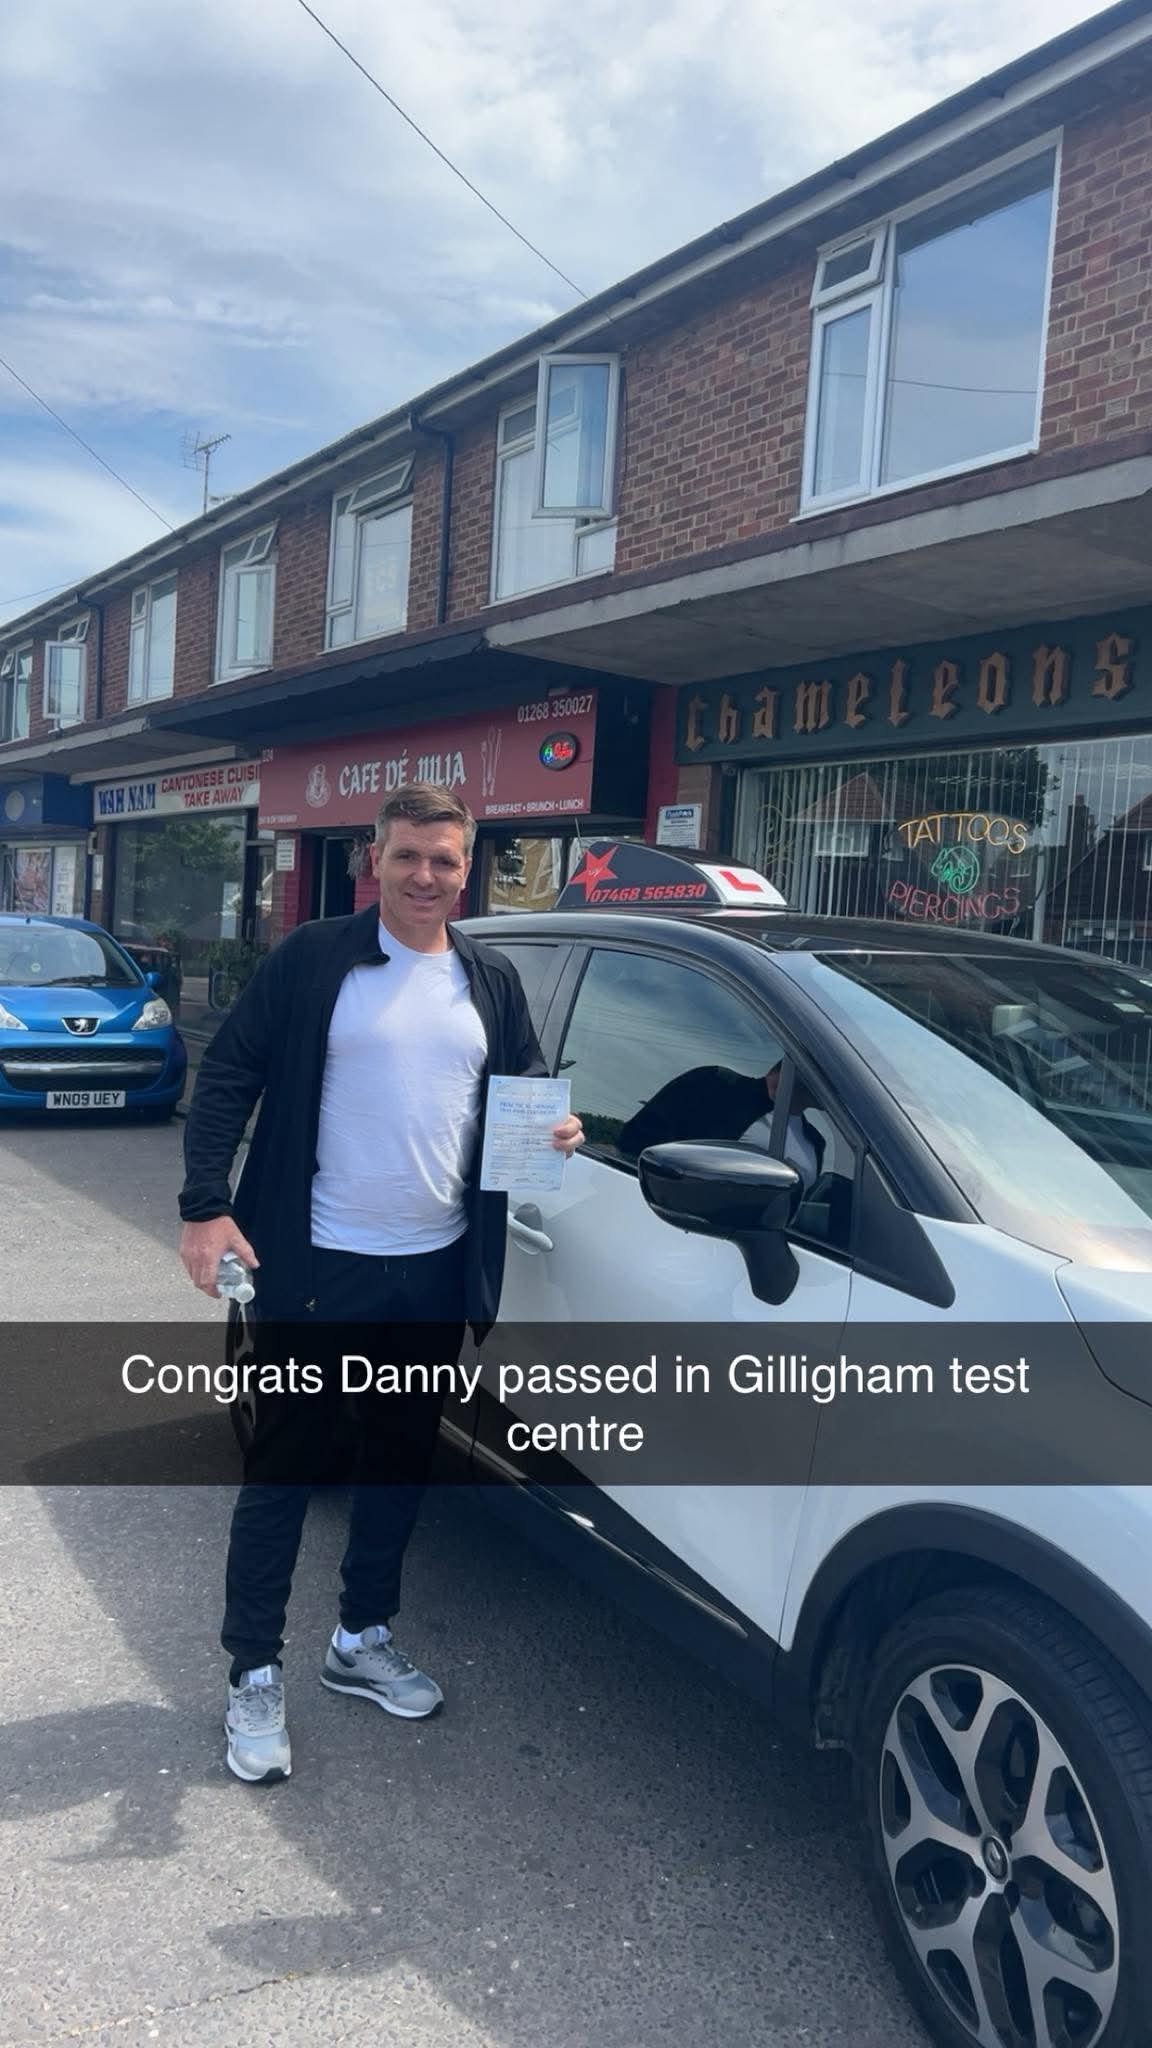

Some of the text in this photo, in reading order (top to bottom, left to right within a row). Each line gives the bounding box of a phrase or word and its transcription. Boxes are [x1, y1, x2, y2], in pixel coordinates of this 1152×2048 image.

[517, 695, 593, 722] 01268 350027
[161, 770, 224, 793] CANTONESE
[339, 748, 467, 799] CAFE DÉ JULIA
[184, 786, 244, 808] TAKE AWAY
[559, 799, 584, 811] LUNCH
[897, 812, 1028, 854] TATTOOS
[590, 883, 707, 903] 07468 565830
[719, 870, 764, 893] L
[886, 880, 1021, 921] PIERCINGS
[53, 1092, 121, 1107] WN09 UEY
